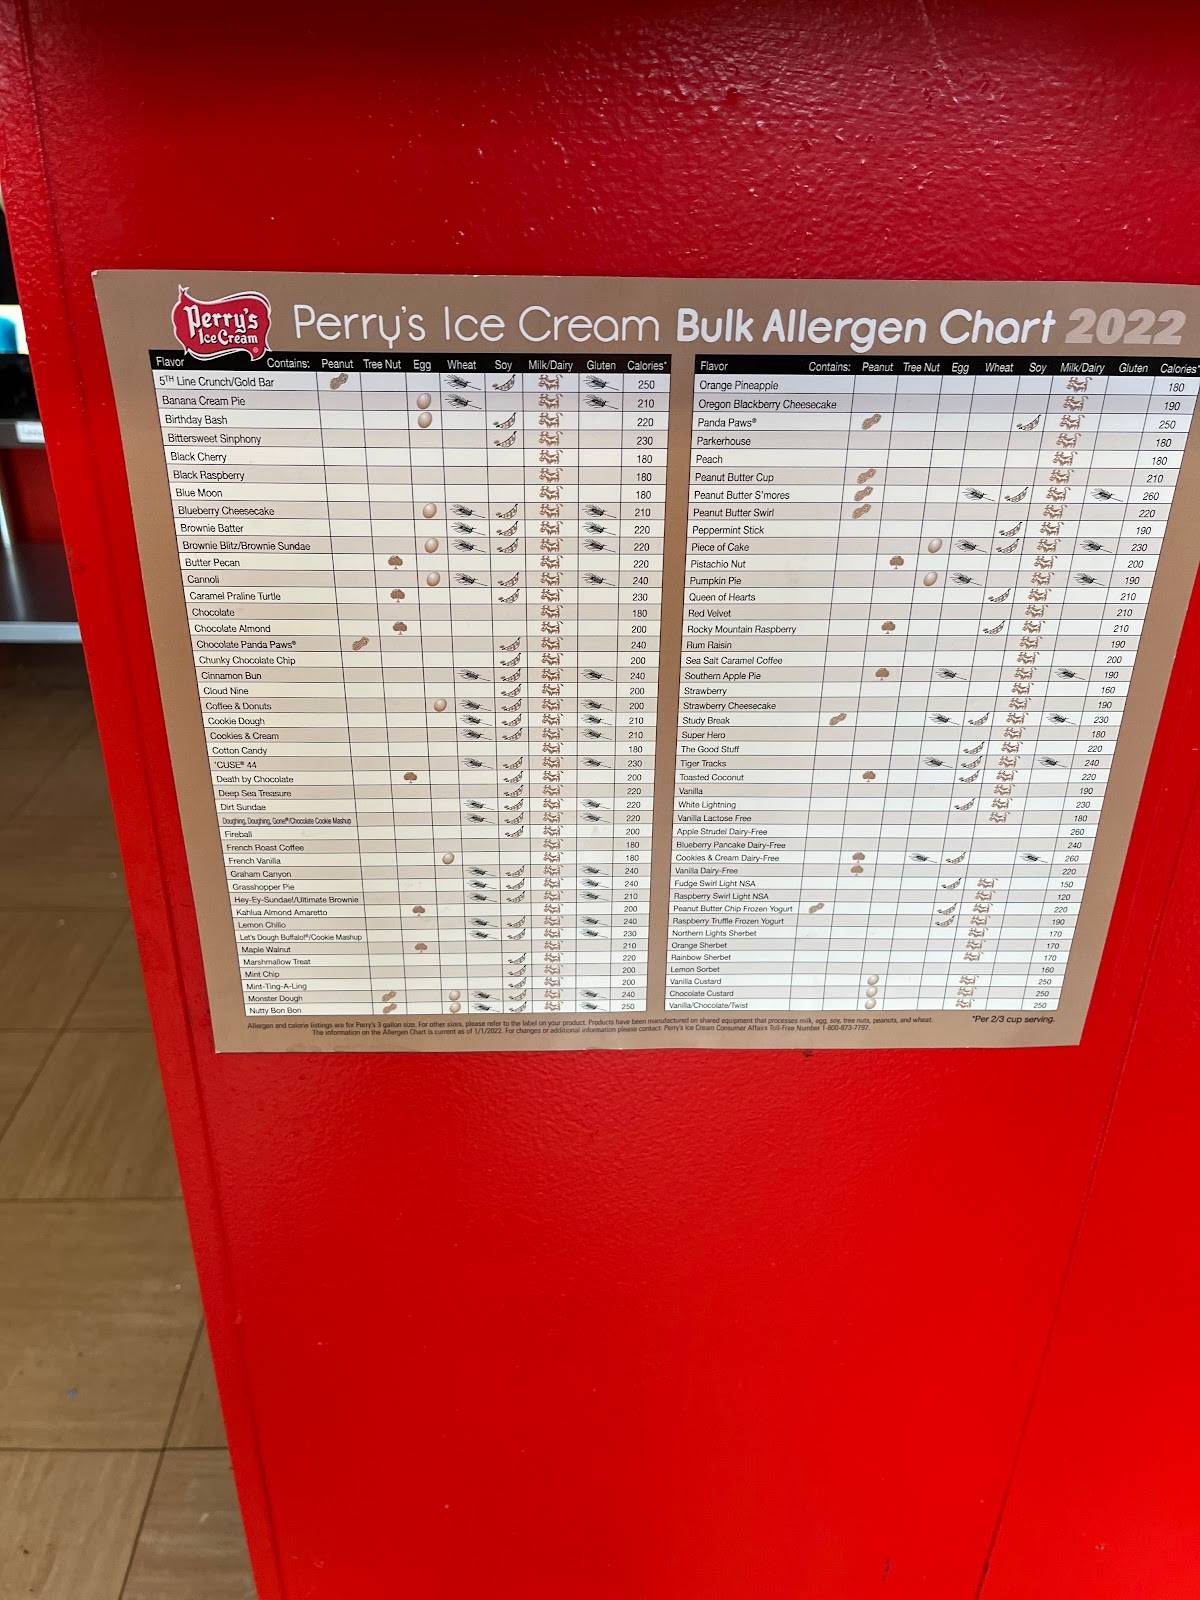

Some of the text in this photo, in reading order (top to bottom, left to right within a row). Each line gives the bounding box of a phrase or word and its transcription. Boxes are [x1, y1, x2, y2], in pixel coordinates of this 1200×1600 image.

[183, 304, 259, 339] Perry's
[294, 305, 1186, 353] Perry's Ice Cream Bulk Allergen Chart 2022
[156, 357, 184, 367] Flavor
[267, 358, 310, 368] Contains:
[321, 359, 354, 369] Peanut
[363, 359, 401, 369] Tree Nut
[413, 360, 431, 372] Egg
[447, 360, 476, 369] Wheat
[495, 360, 513, 372] Soy
[528, 360, 573, 372] Milk/Dairy
[587, 360, 616, 370] Gluten
[701, 361, 728, 371] Flavor
[809, 362, 851, 371] Contains:
[862, 362, 894, 371] Peanut
[903, 362, 940, 372] Tree Nut
[951, 362, 969, 374] Egg
[985, 363, 1014, 372] Wheat
[1029, 362, 1047, 375] Soy
[1060, 363, 1106, 375] Milk/Dairy
[1119, 363, 1148, 373] Gluten
[176, 376, 197, 386] Line
[197, 376, 257, 387] Crunch/Gold
[257, 377, 275, 387] Bar
[638, 379, 655, 390] 250
[699, 379, 779, 392] Orange Pineapple
[1169, 382, 1185, 393] 180
[162, 395, 246, 406] Banana Cream Pie
[637, 398, 655, 409] 210
[698, 398, 837, 411] Oregon Blackberry Cheesecake
[1164, 401, 1181, 411] 190
[164, 414, 228, 427] Birthday Bash
[637, 417, 654, 427] 220
[167, 433, 262, 446] Bittersweet Sinphony
[636, 436, 654, 446] 230
[696, 436, 751, 446] Parkerhouse
[1156, 438, 1172, 448] 180
[694, 490, 790, 500] Peanut Butter S'mores
[1142, 491, 1160, 501] 260
[692, 525, 765, 536] Peppermint Stick
[1136, 526, 1152, 535] 190
[184, 557, 241, 567] Butter Pecan
[633, 559, 649, 569] 220
[690, 559, 746, 569] Pistachio Nut
[1127, 559, 1144, 569] 200
[189, 591, 281, 601] Caramel Praline Turtle
[632, 592, 648, 602] 230
[688, 592, 756, 602] Queen of Hearts
[1120, 592, 1137, 601] 210
[194, 624, 271, 633] Chocolate Almond
[631, 625, 647, 634] 200
[687, 624, 797, 636] Rocky Mountain Raspberry
[1113, 624, 1130, 633] 210
[684, 671, 761, 682] Southern Apple Pie
[1105, 671, 1119, 679] 190
[203, 686, 249, 695] Cloud Nine
[629, 687, 645, 695] 200
[207, 716, 265, 727] Cookie Dough
[629, 716, 644, 725] 210
[682, 716, 730, 726] Study Break
[1093, 715, 1109, 724] 230
[680, 759, 727, 769] Tiger Tracks
[1084, 759, 1100, 767] 240
[220, 803, 267, 811] Dirt Sundae
[626, 801, 641, 809] 220
[678, 801, 737, 810] White Lightning
[1075, 801, 1091, 809] 230
[224, 830, 253, 838] Fireball
[625, 828, 640, 836] 200
[228, 857, 281, 865] French Vanilla
[626, 854, 640, 862] 180
[700, 867, 738, 876] Dairy-Free
[1062, 867, 1077, 875] 220
[674, 879, 698, 889] Fudge
[699, 879, 718, 887] Swirl
[719, 880, 738, 889] Light
[624, 905, 638, 913] 200
[671, 941, 727, 951] Orange Sherbet
[1047, 942, 1060, 950] 170
[243, 958, 292, 966] Marshmallow
[696, 965, 720, 973] Sorbet
[669, 1001, 748, 1009] Vanilla/Chocolate/Twist
[249, 1007, 269, 1015] Nutty
[990, 1015, 1005, 1023] 2/3
[1006, 1016, 1023, 1024] cup
[1024, 1015, 1055, 1025] serving.
[247, 1022, 273, 1030] Allergen
[382, 1028, 408, 1036] Allergen
